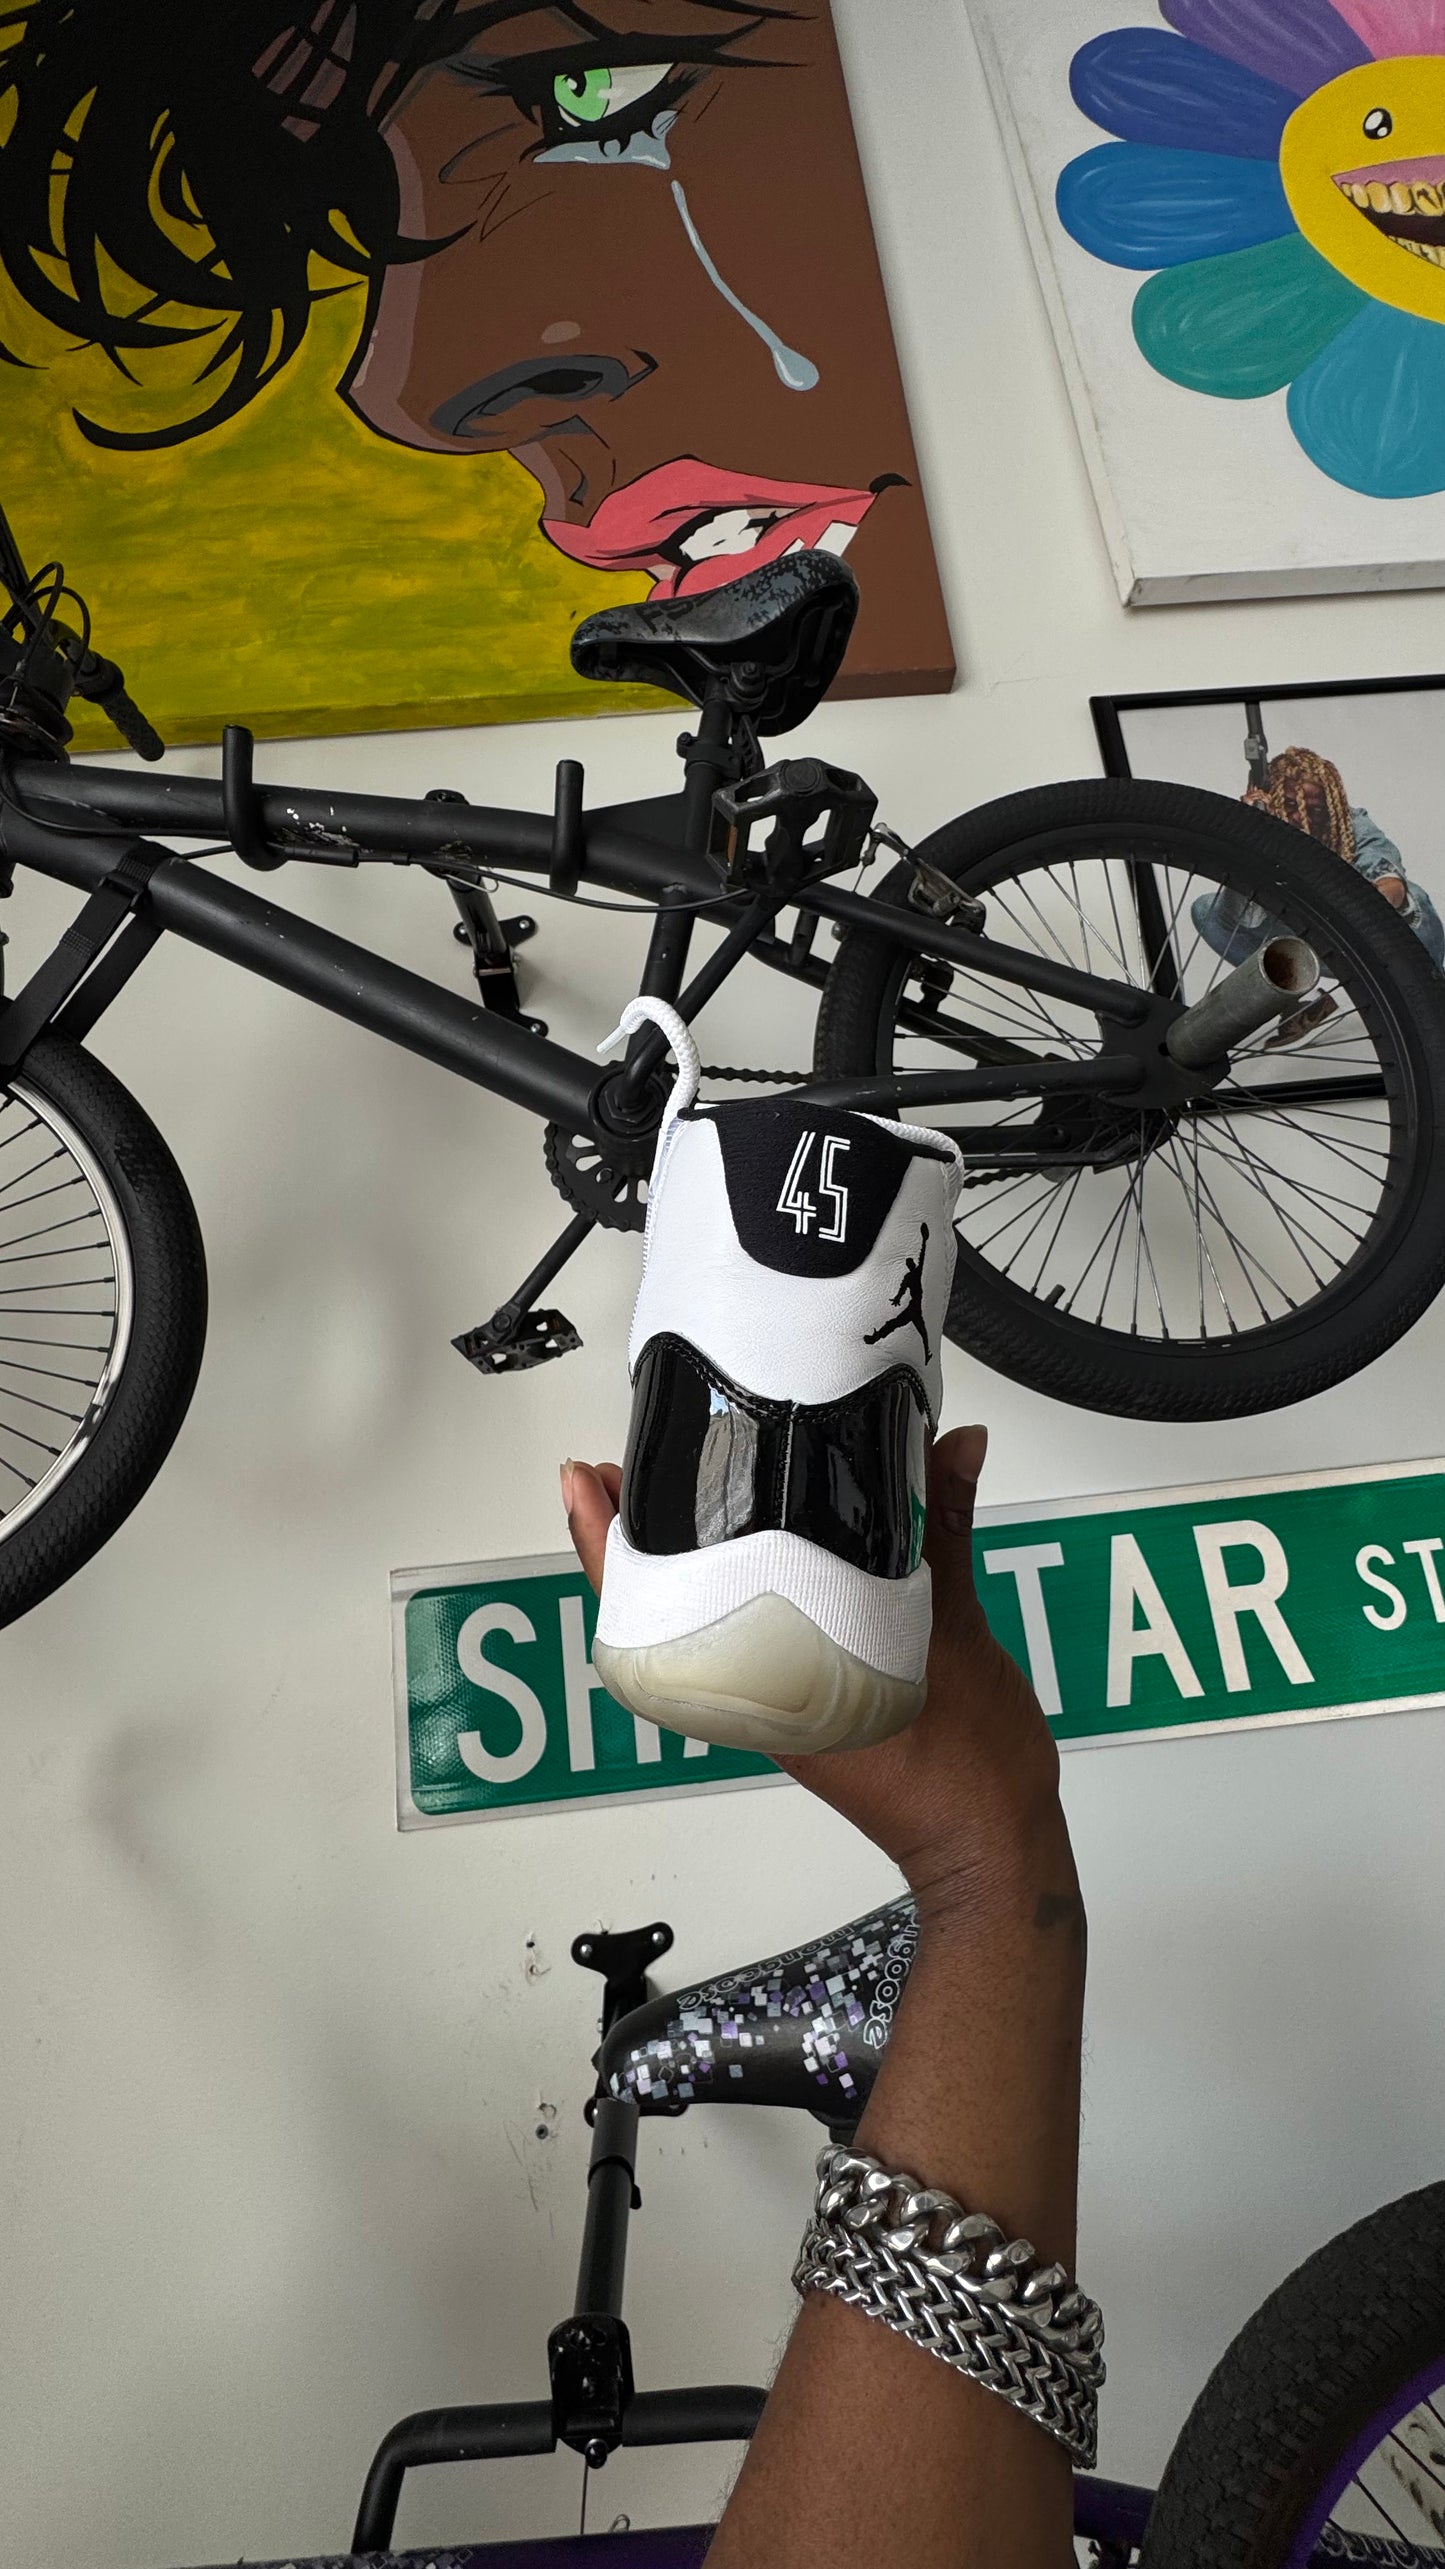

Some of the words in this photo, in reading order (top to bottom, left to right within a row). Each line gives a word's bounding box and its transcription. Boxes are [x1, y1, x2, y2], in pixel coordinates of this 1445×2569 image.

[776, 1131, 850, 1243] 45
[1355, 1537, 1445, 1631] ST
[676, 1925, 855, 2011] mongoose
